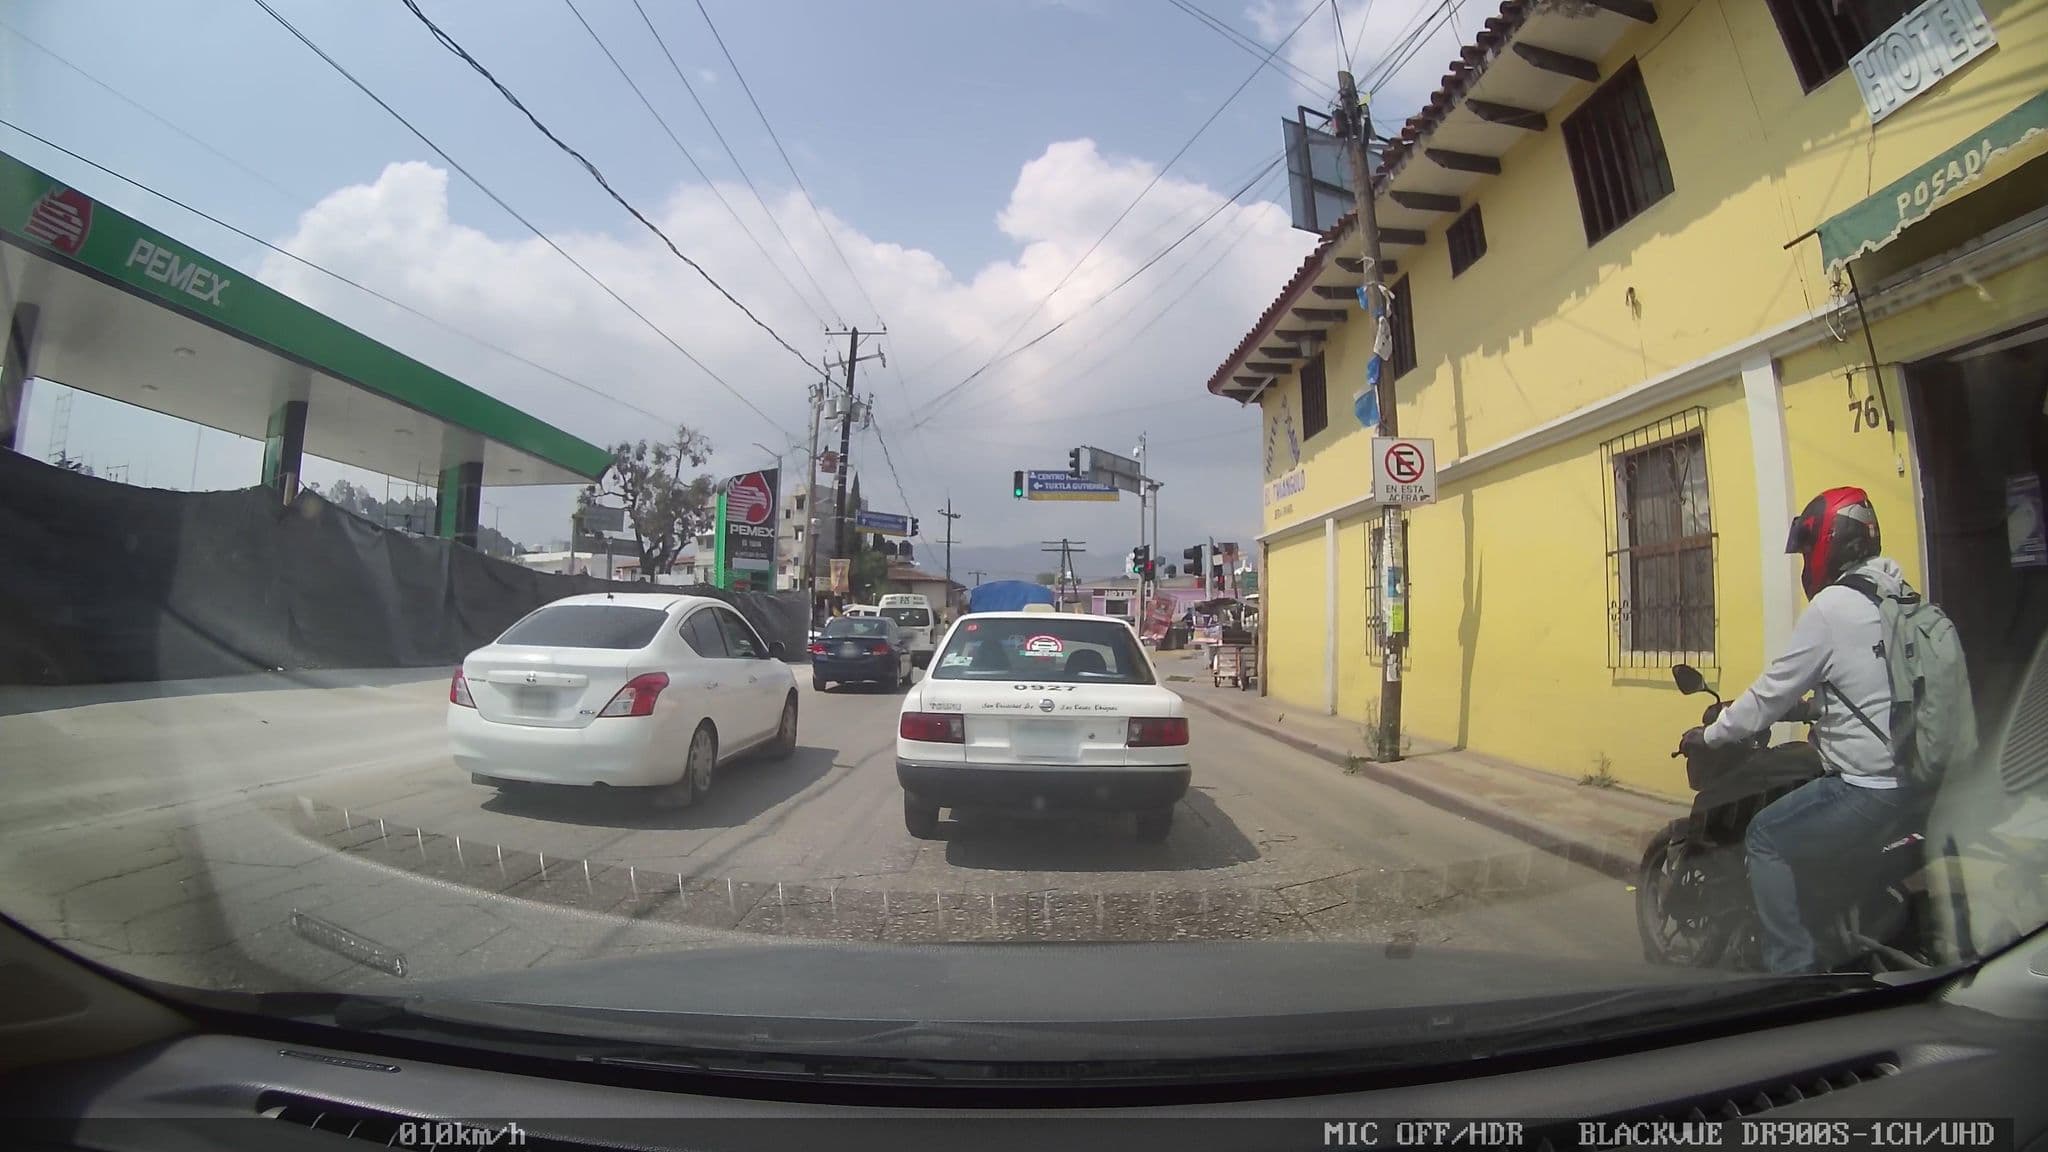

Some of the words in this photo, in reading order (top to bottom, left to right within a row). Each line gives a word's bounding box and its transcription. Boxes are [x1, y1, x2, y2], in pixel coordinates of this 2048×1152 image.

[1853, 0, 1991, 115] HOTEL
[1896, 138, 1992, 220] POSADA
[126, 238, 231, 307] PEMEX
[1848, 395, 1880, 433] 76
[1044, 482, 1071, 490] TUXTLA
[1385, 485, 1397, 493] EN
[1401, 485, 1424, 493] ESTA
[1389, 494, 1418, 502] ACERA
[730, 524, 775, 538] PEMEX
[1014, 684, 1077, 692] 0927
